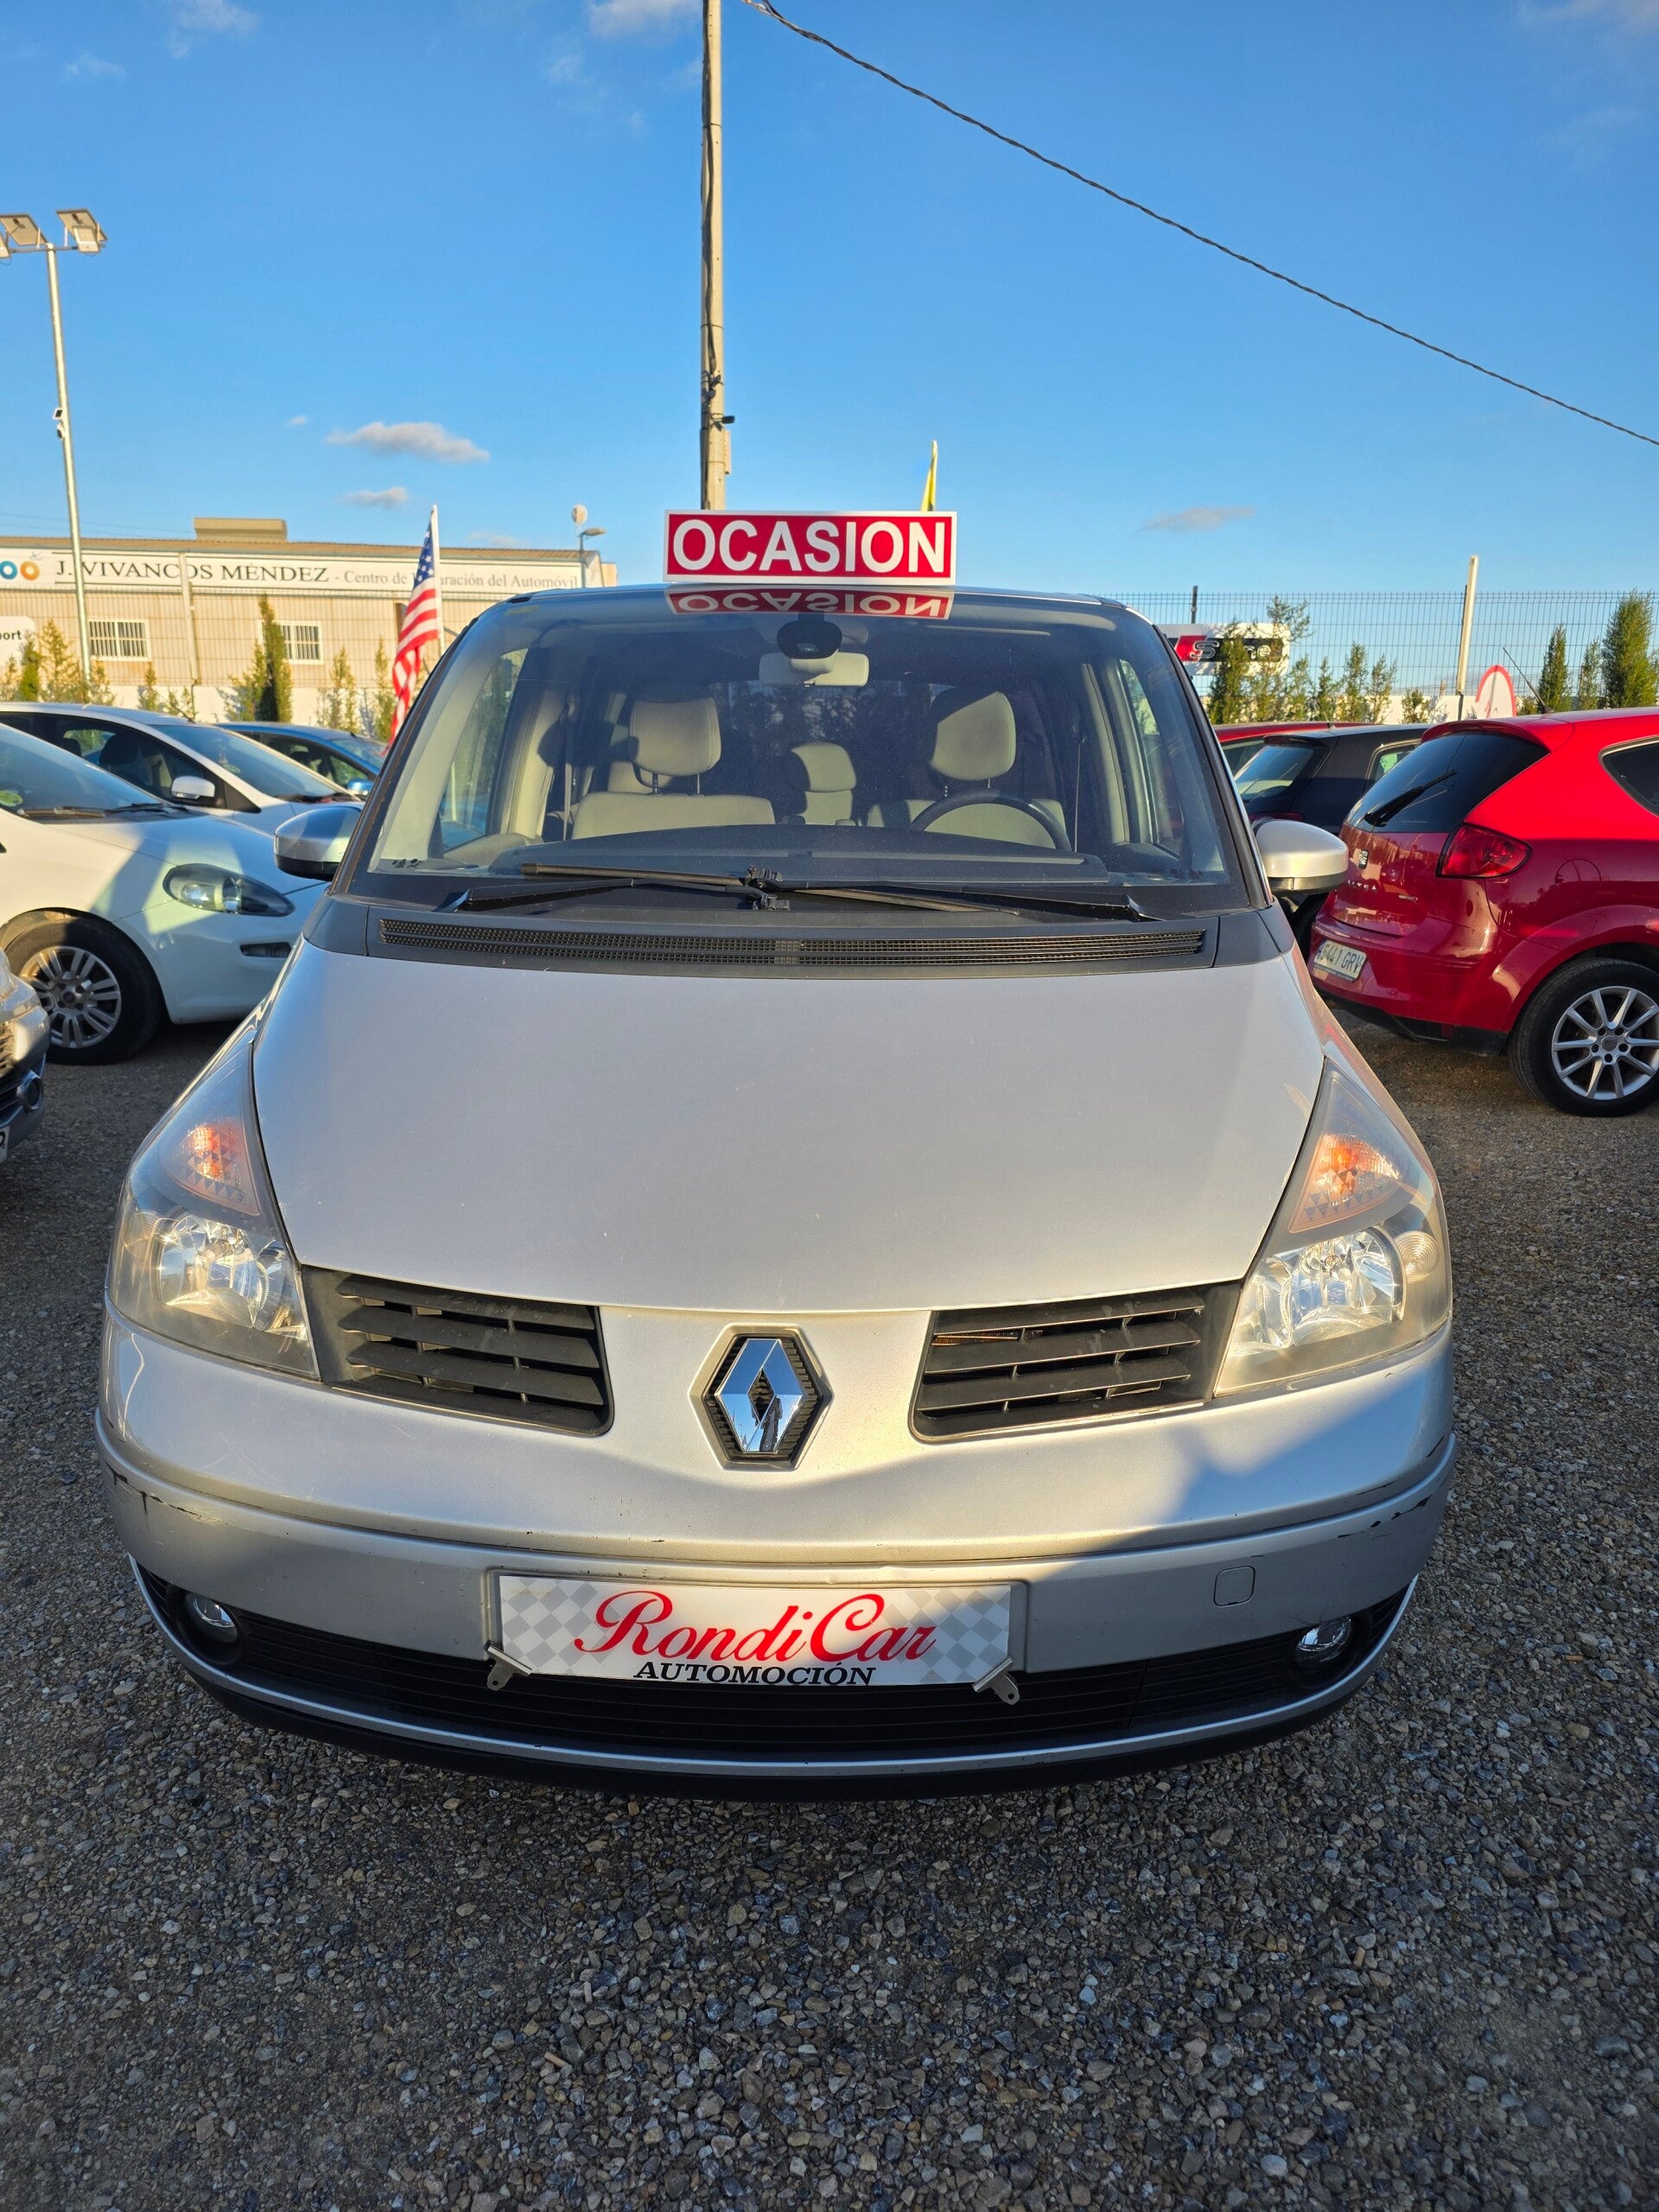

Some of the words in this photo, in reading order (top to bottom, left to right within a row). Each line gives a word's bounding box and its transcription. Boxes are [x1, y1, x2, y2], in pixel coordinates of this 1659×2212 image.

[673, 519, 945, 573] OCASION
[82, 562, 213, 580] VIVANCOS
[220, 562, 329, 582] MÉNDEZ
[344, 570, 389, 584] Centro
[392, 572, 408, 584] de
[487, 575, 506, 587] del
[512, 575, 577, 588] Automóvil
[0, 630, 22, 640] ort
[632, 1660, 876, 1687] AUTOMOCIÓN
